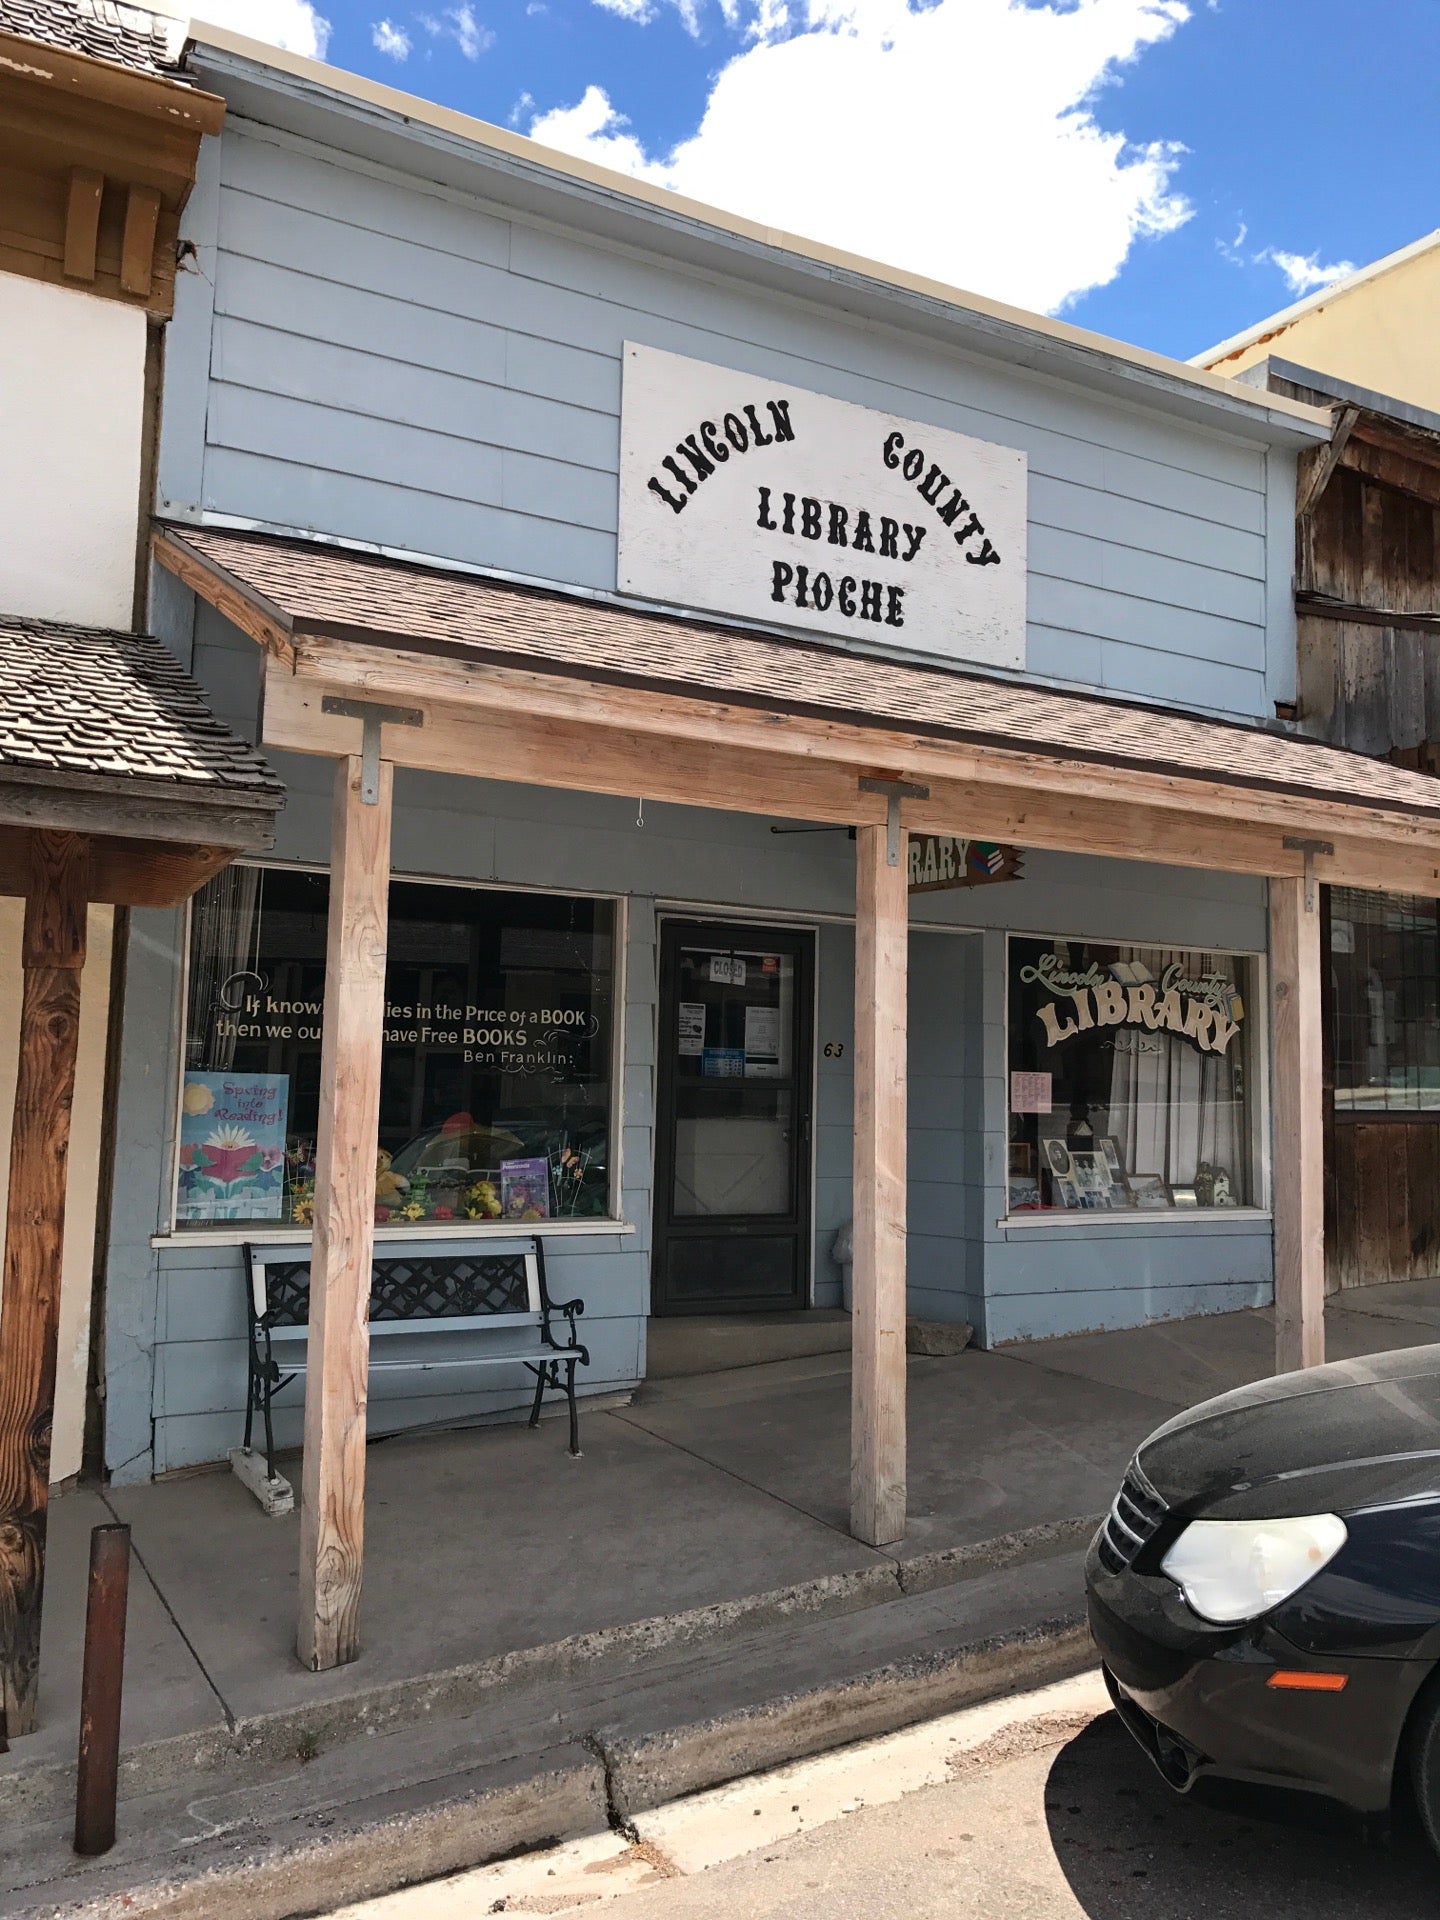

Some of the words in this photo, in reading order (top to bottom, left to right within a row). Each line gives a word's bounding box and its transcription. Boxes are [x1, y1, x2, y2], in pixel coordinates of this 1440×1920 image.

[647, 399, 795, 514] LINCOLN
[883, 432, 1001, 567] COUNTY
[757, 487, 926, 562] LIBRARY
[772, 561, 904, 627] PIOCHE
[908, 836, 971, 885] RARY
[714, 961, 743, 978] CLOSED
[1020, 953, 1106, 997] Lincoln
[1161, 962, 1228, 1016] County
[416, 1002, 431, 1019] in
[435, 1004, 462, 1020] the
[465, 1005, 506, 1022] Price
[509, 1011, 526, 1027] of
[529, 1012, 538, 1024] a
[541, 1009, 586, 1026] BOOK
[1036, 981, 1241, 1055] LIBRARY
[216, 1020, 261, 1037] then
[266, 1025, 293, 1039] we
[421, 1027, 458, 1043] Free
[463, 1028, 527, 1046] BOOKS
[463, 1050, 495, 1063] Ben
[823, 1043, 844, 1058] 63
[223, 1081, 277, 1100] Spring
[214, 1108, 283, 1126] Reading!
[238, 1098, 264, 1111] into
